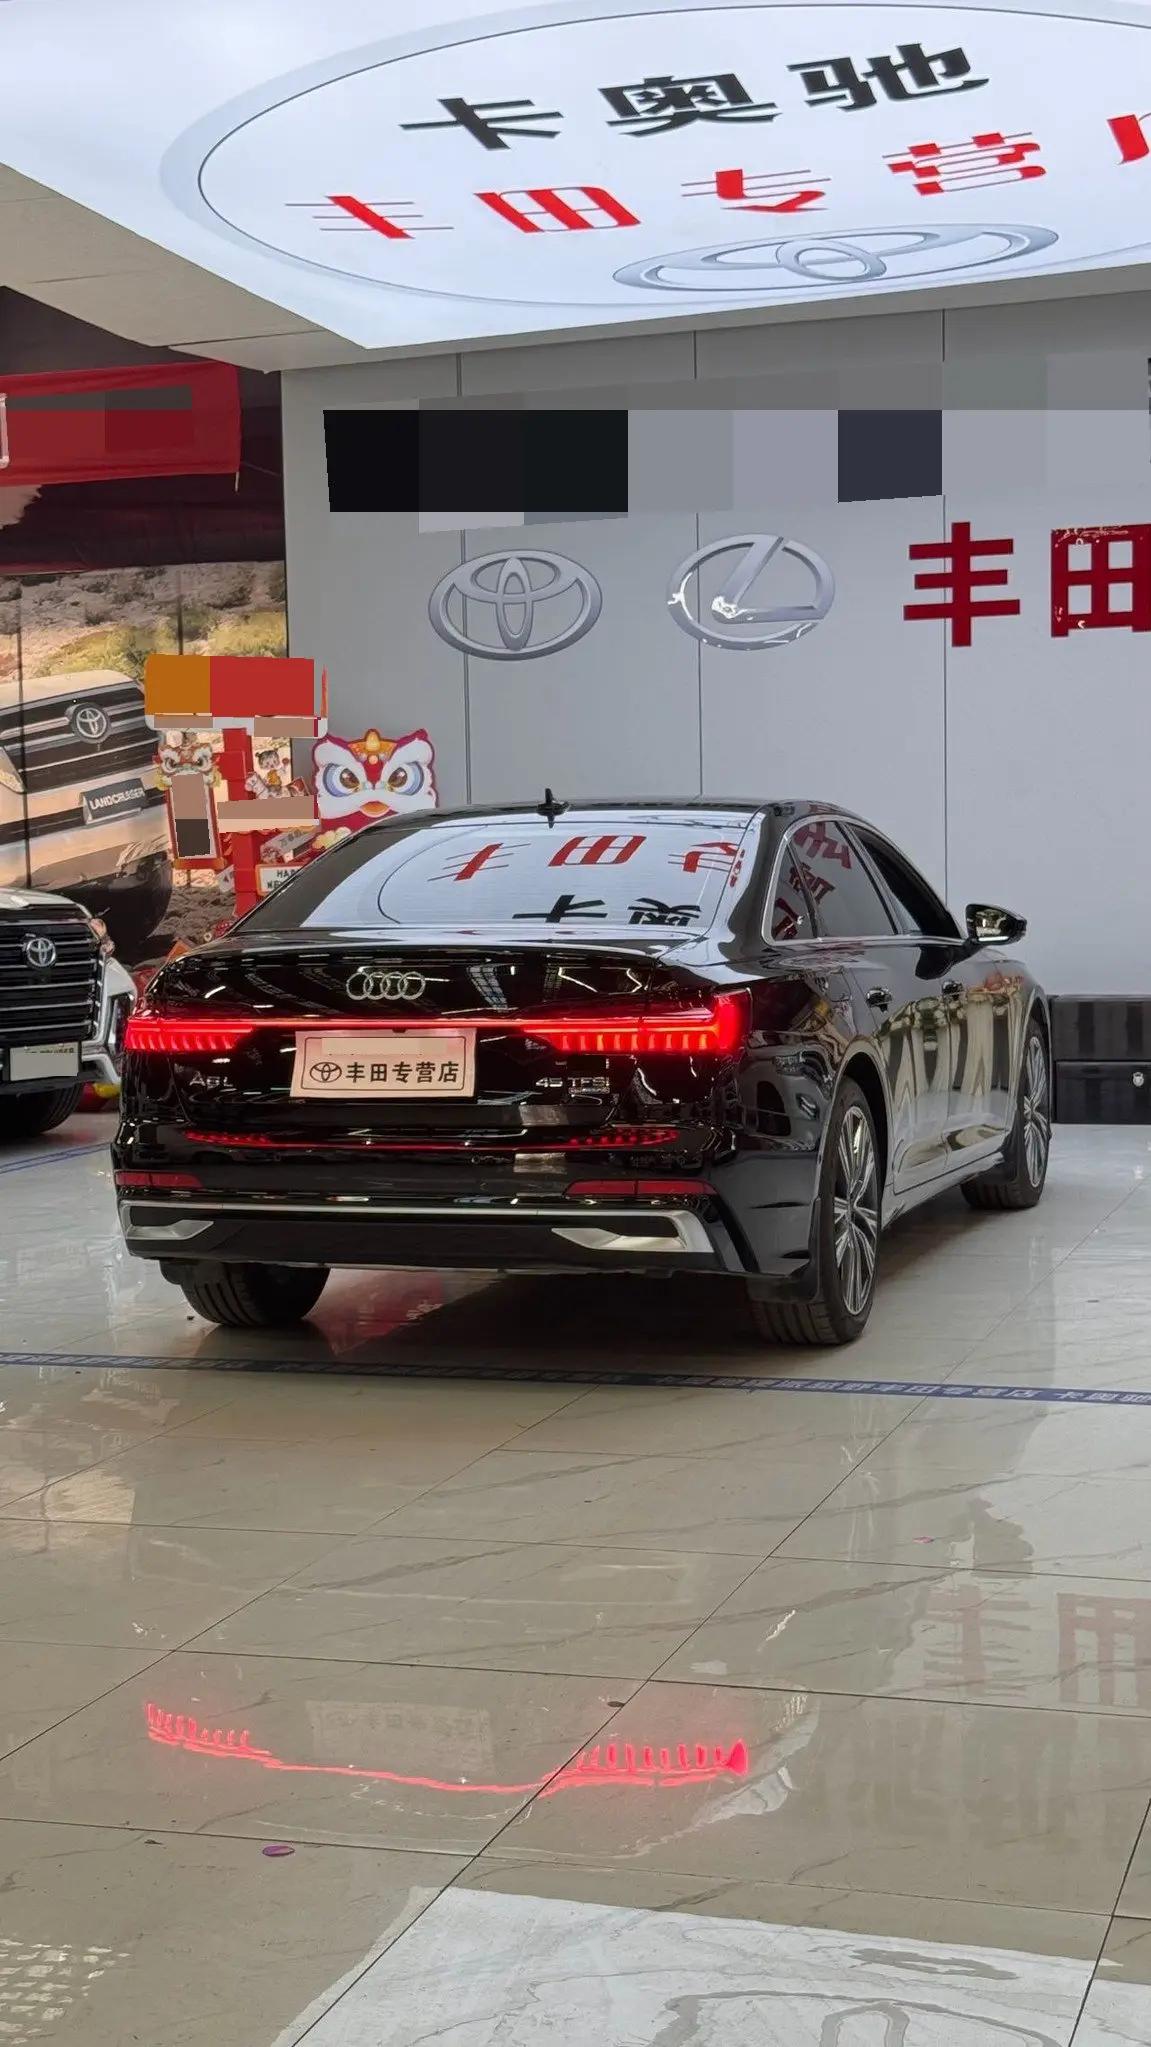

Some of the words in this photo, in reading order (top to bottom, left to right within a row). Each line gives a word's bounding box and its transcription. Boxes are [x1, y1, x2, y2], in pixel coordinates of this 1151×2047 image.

[400, 43, 990, 151] 卡奥驰
[903, 521, 1151, 647] 丰田
[345, 1061, 460, 1083] 丰田专营店
[567, 1076, 610, 1087] TFSI
